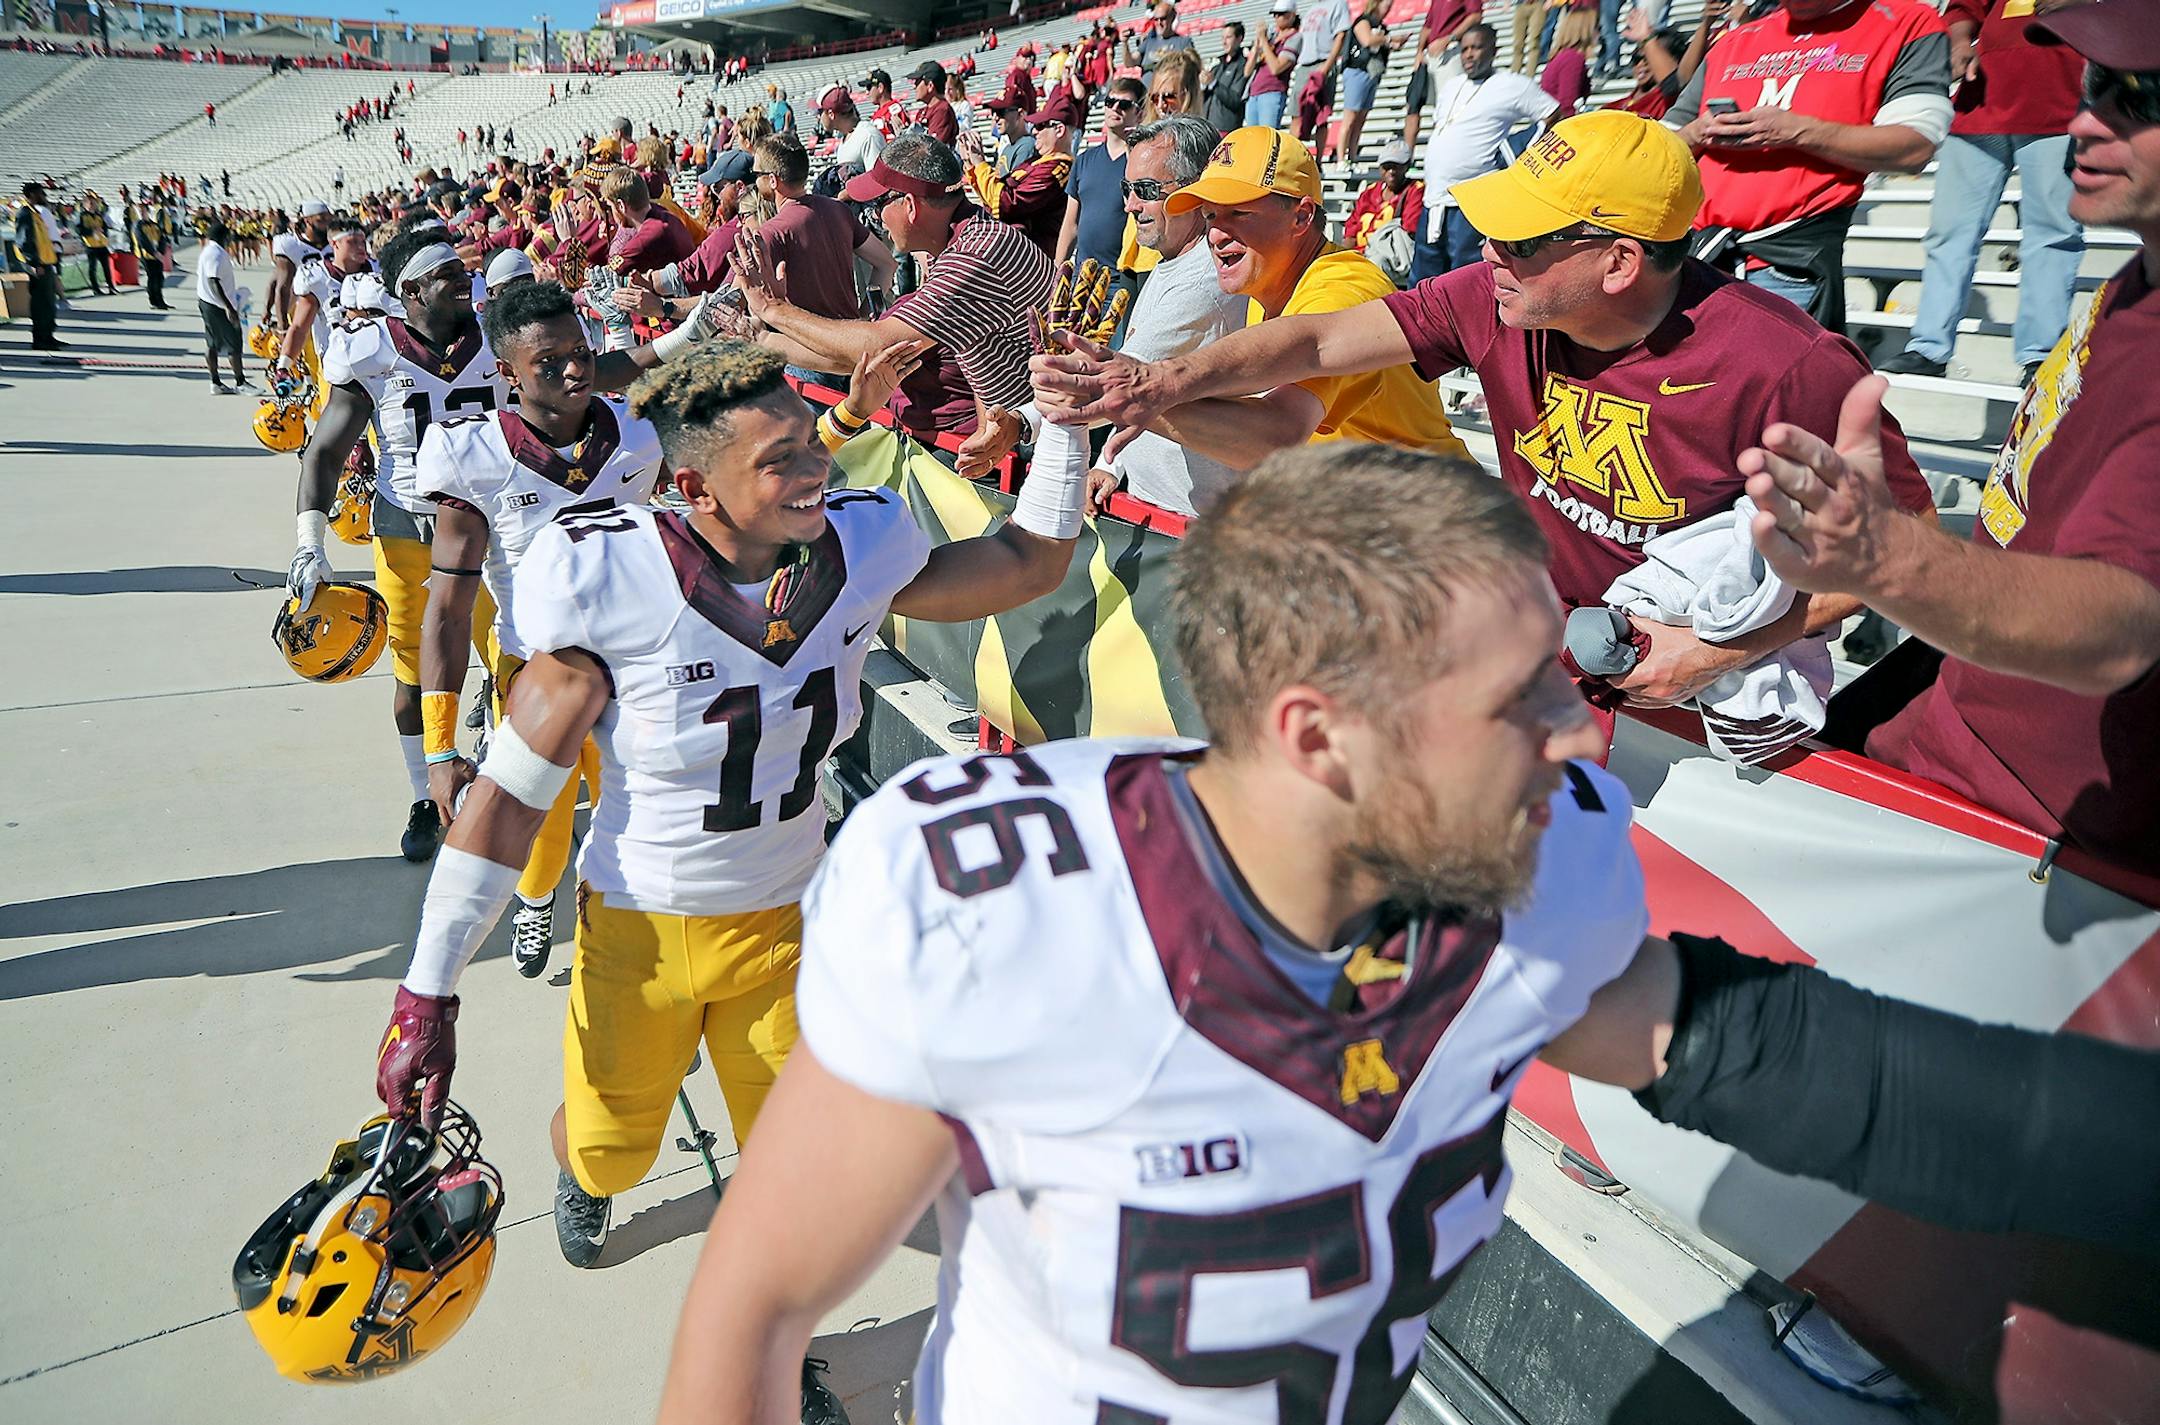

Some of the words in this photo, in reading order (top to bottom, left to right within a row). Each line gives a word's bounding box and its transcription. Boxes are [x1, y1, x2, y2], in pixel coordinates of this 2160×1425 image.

[659, 2, 700, 16] GEICO
[1756, 46, 1832, 64] MARYLAN
[1755, 73, 1804, 111] M
[1520, 151, 1545, 179] TBALL
[1531, 130, 1577, 171] PHER
[1513, 371, 1687, 524] M
[702, 665, 838, 832] 11
[1098, 1100, 1506, 1424] 56
